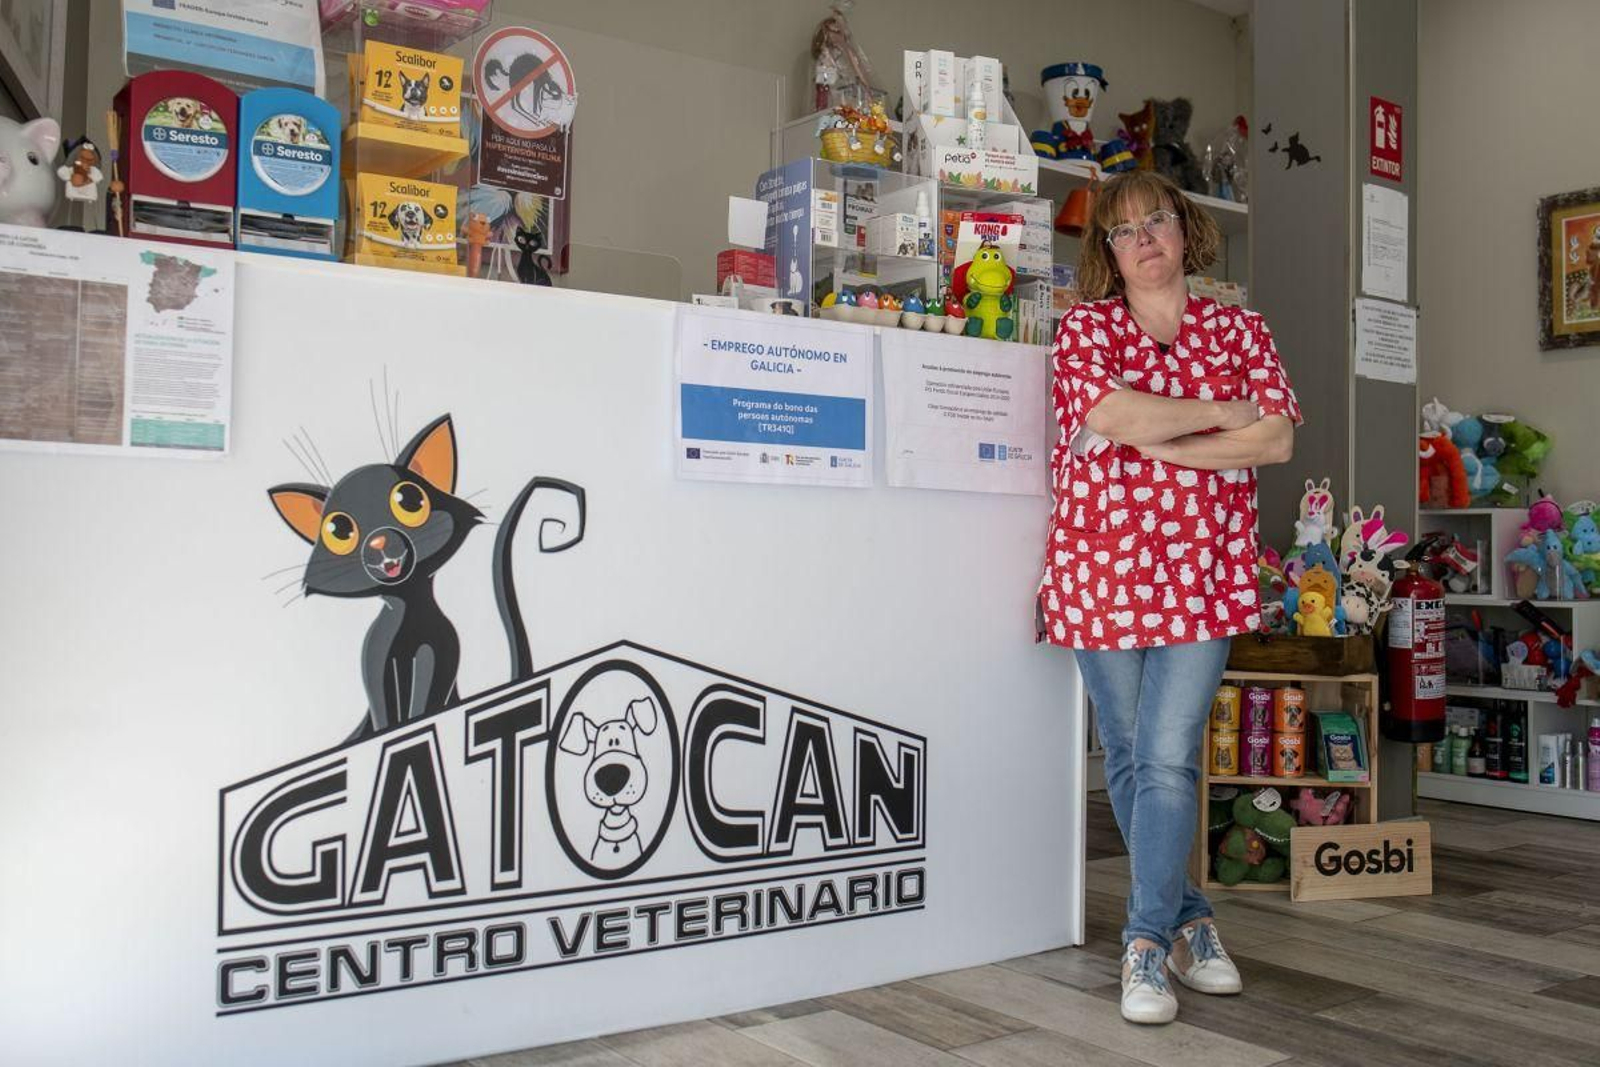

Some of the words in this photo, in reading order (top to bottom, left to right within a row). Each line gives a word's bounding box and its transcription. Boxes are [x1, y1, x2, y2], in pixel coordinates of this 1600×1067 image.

[395, 50, 436, 70] Scalibor
[375, 69, 392, 88] 12
[169, 131, 219, 146] Seresto
[277, 146, 323, 162] Seresto
[1372, 156, 1401, 176] EXTINTOR
[389, 181, 430, 198] Scalibor
[370, 201, 388, 219] 12
[974, 223, 1001, 236] KONG
[711, 339, 764, 355] EMPREGO
[767, 345, 831, 362] AUTÓNOMO
[833, 353, 847, 363] EN
[750, 360, 794, 374] GALICIA
[733, 398, 771, 410] Programa
[773, 402, 783, 411] do
[784, 403, 803, 412] bono
[804, 405, 818, 414] das
[738, 412, 769, 421] persoas
[771, 413, 813, 424] autónomas
[1249, 692, 1271, 701] Gosbi
[1248, 736, 1270, 746] Gosbi
[1314, 839, 1414, 876] Gosbi
[217, 922, 527, 1009] CENTRO
[547, 866, 926, 957] VETERINARIO
